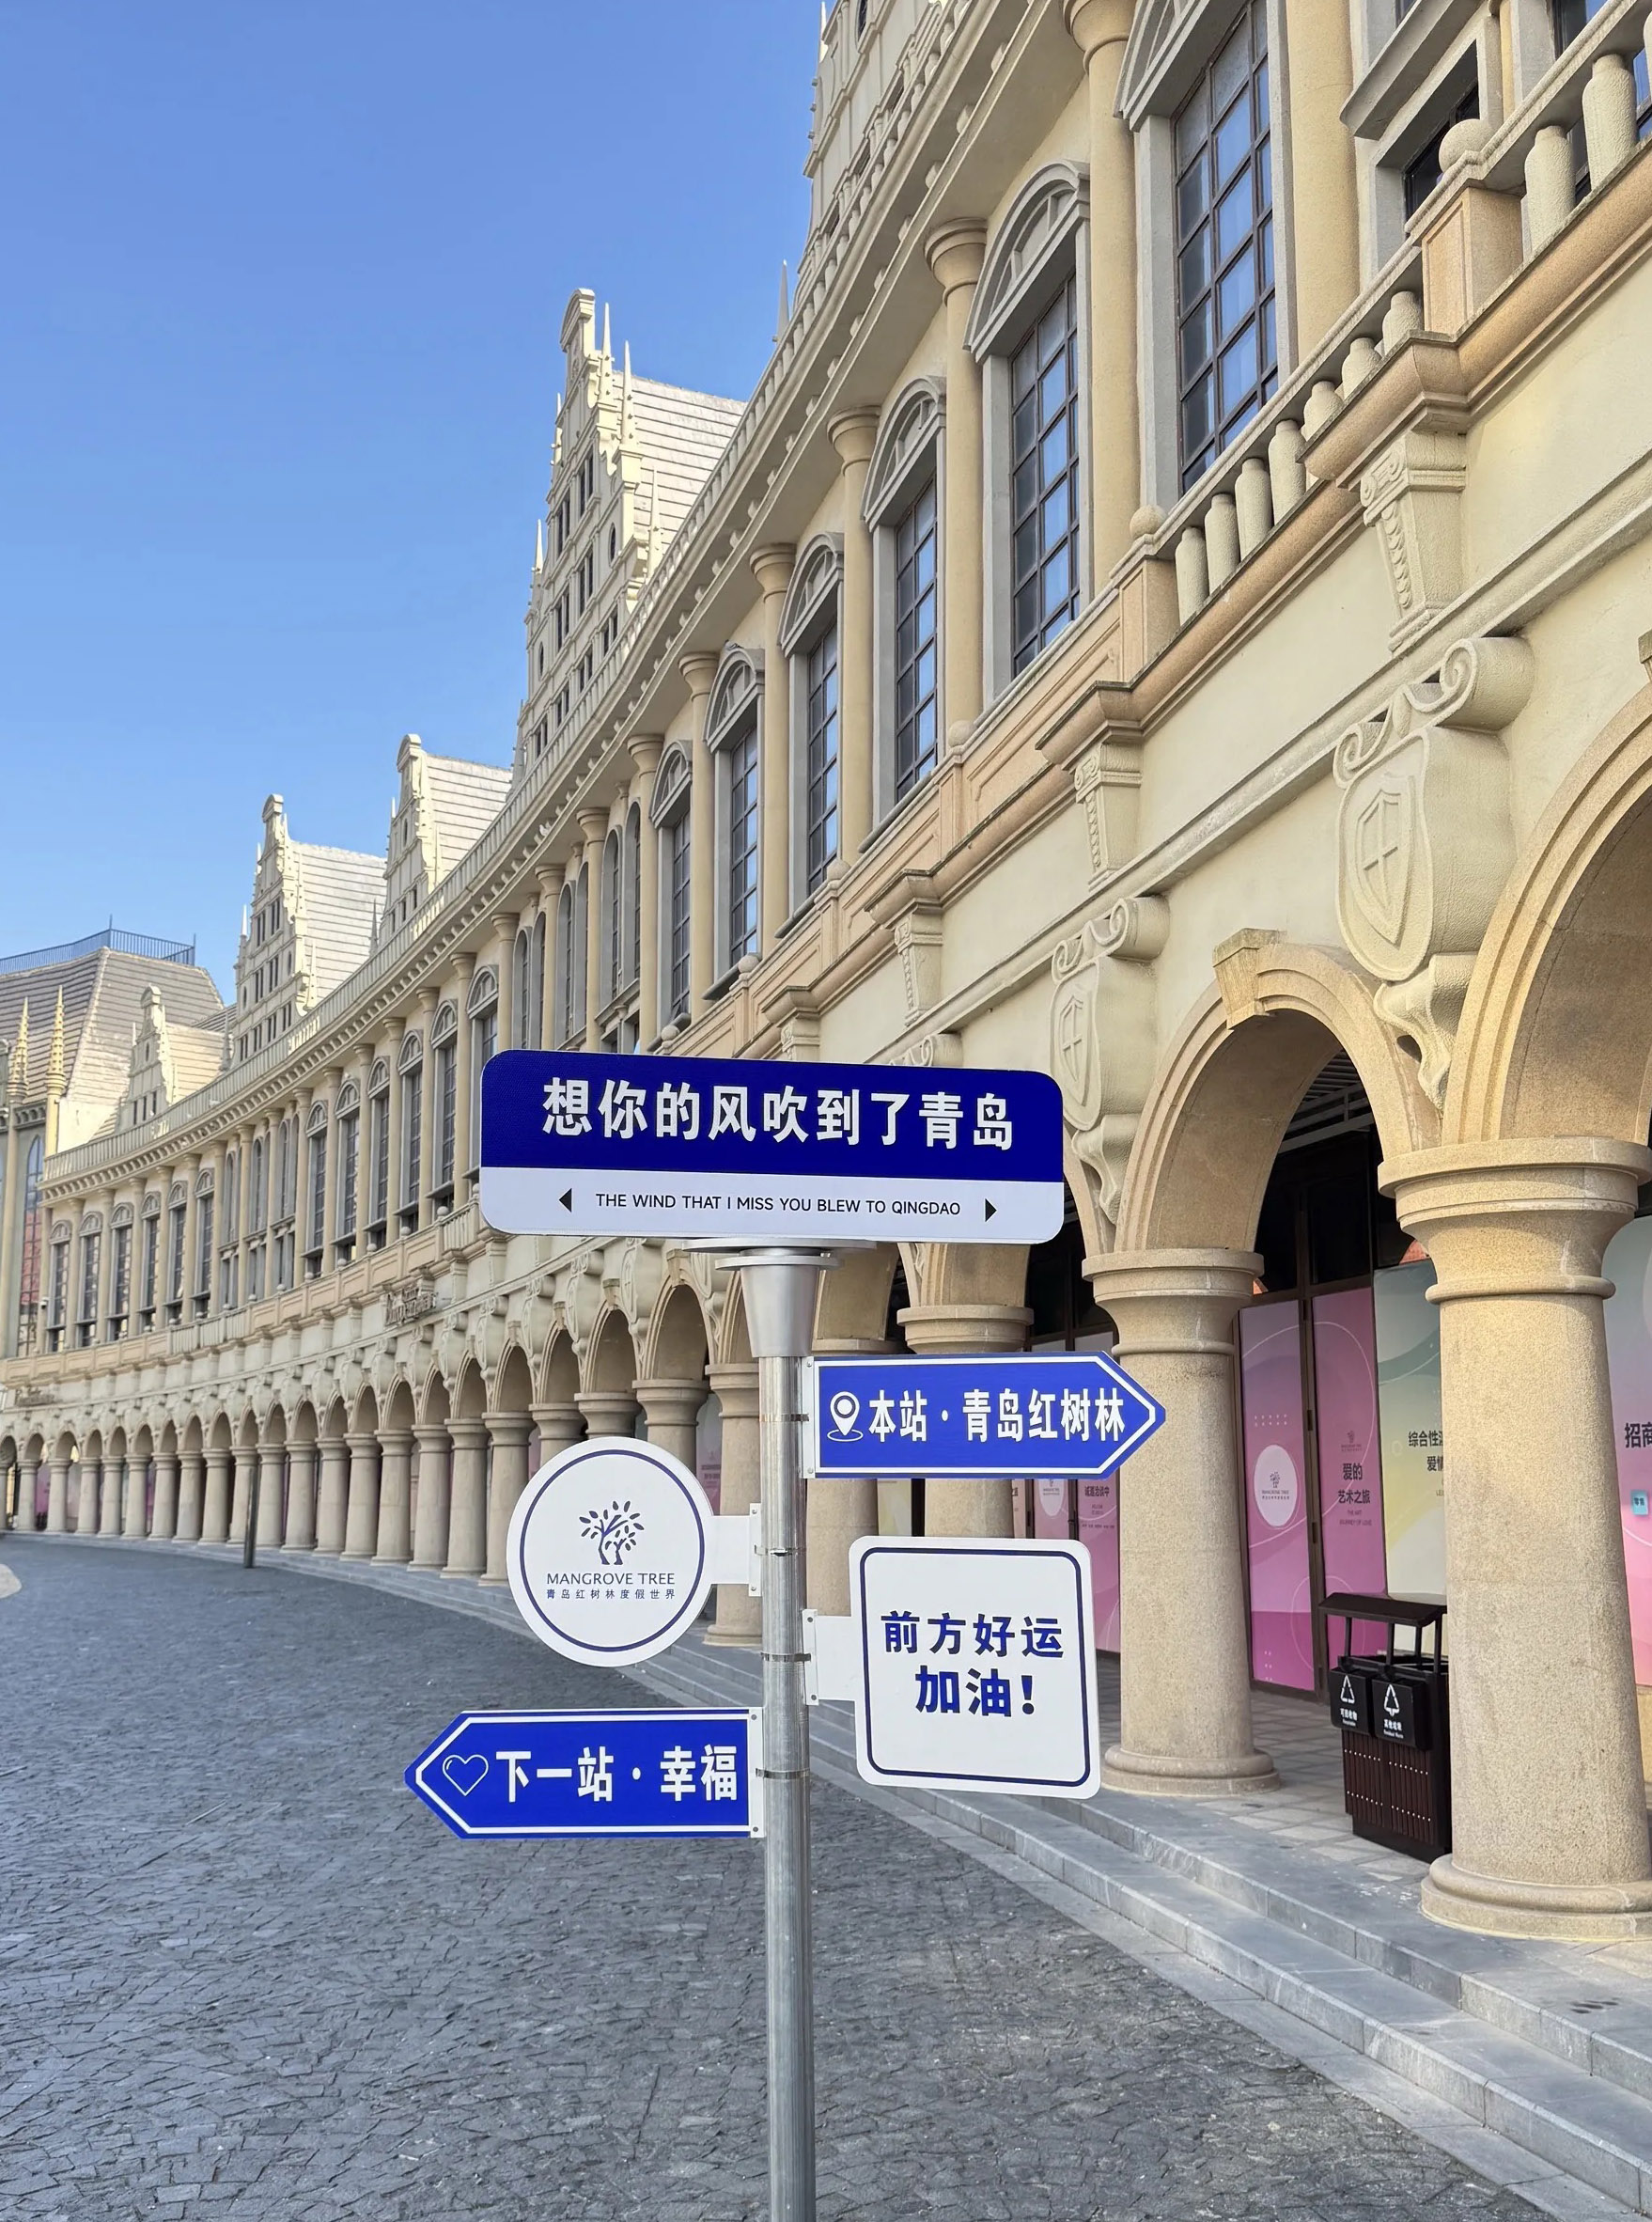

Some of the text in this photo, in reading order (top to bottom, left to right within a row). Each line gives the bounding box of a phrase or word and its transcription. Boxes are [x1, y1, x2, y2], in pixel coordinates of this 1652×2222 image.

[542, 1077, 1013, 1150] 想你的风吹到了青岛
[595, 1193, 960, 1215] THE WIND THAT I MISS YOU BLEW TO QINGDAO
[1343, 1463, 1363, 1480] 爱的
[1338, 1490, 1370, 1504] 艺术之旅
[547, 1573, 676, 1586] MANGROVE TREE
[546, 1588, 676, 1600] 青岛红树林度假世界
[881, 1611, 1065, 1658] 前方好运
